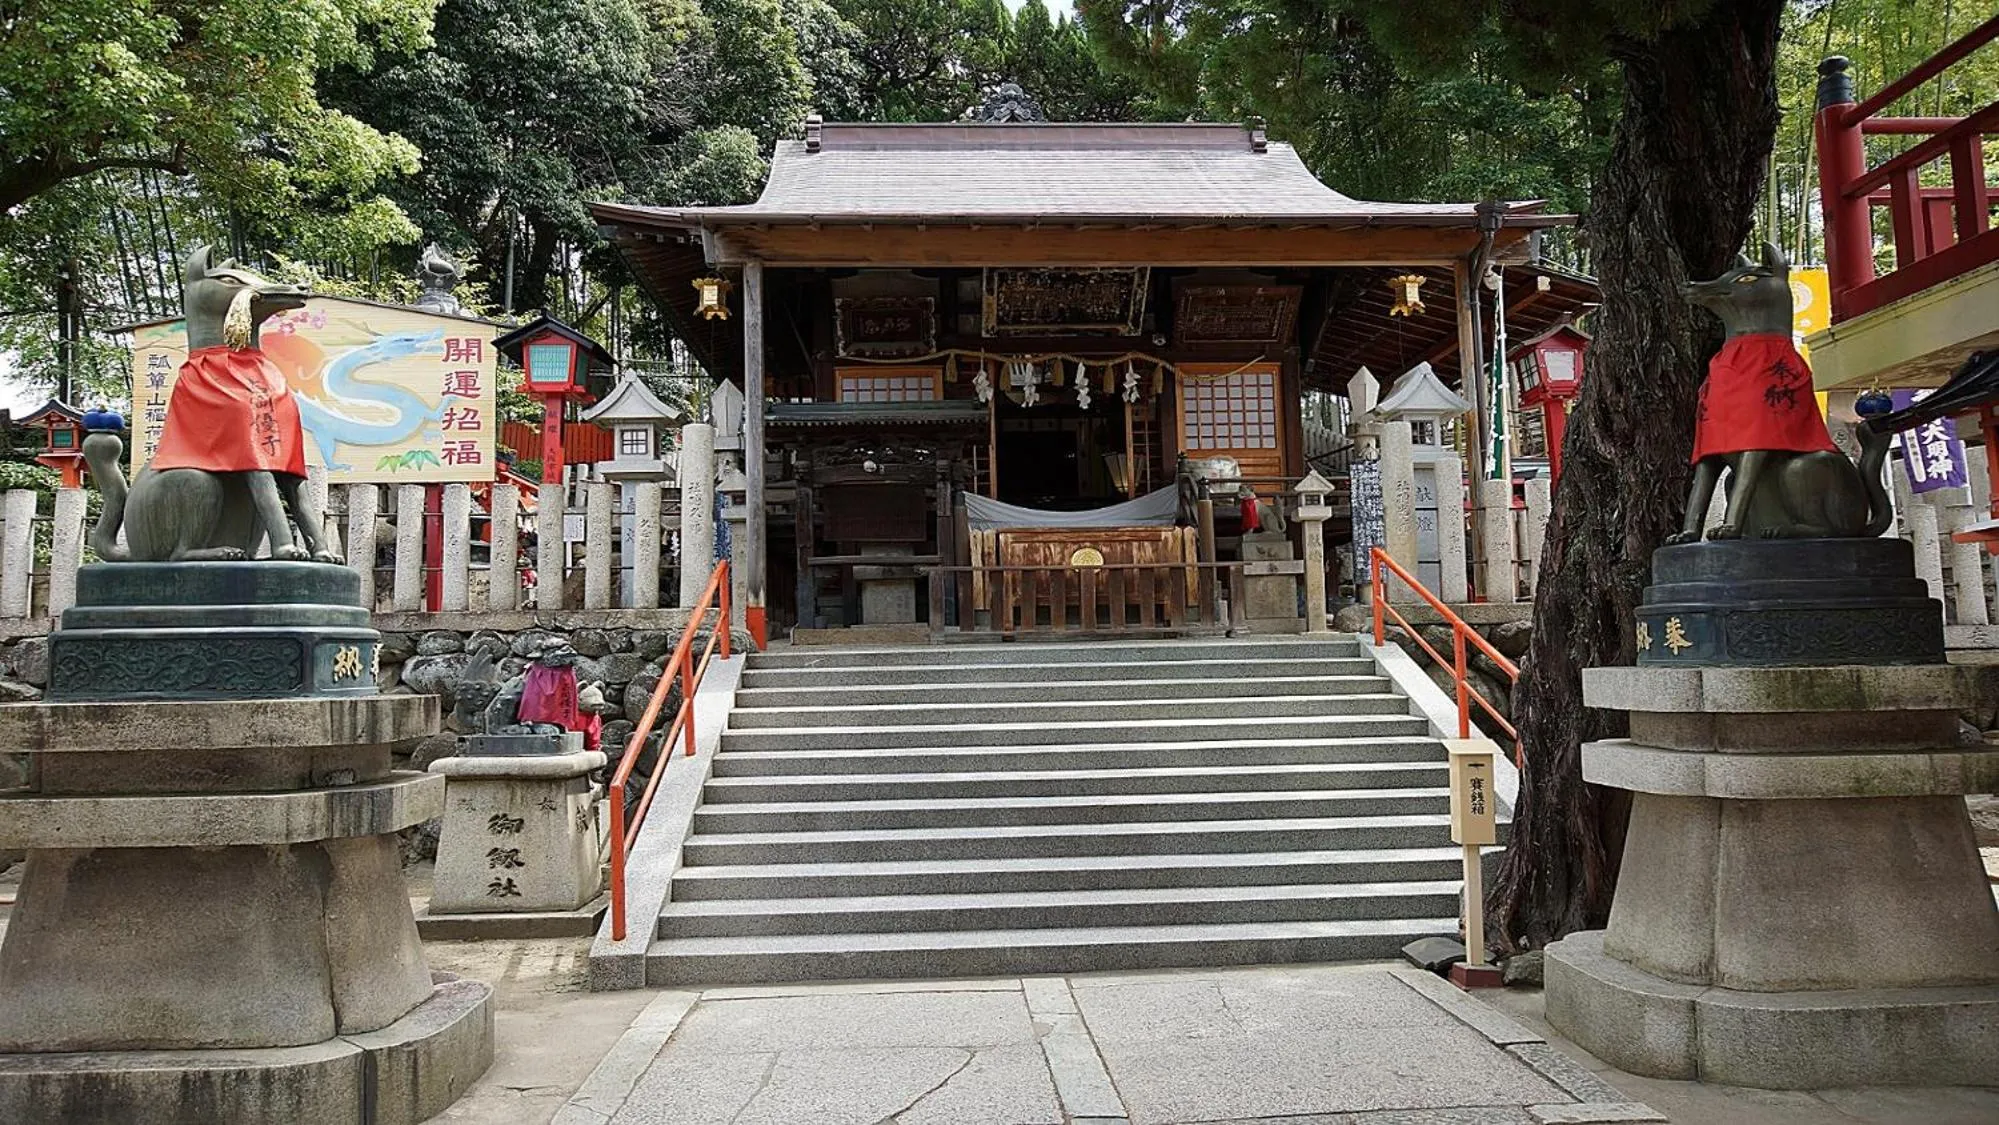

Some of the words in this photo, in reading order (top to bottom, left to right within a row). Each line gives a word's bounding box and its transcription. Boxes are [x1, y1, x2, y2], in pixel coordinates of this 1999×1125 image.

[441, 337, 483, 466] 開運招福
[1920, 417, 1955, 481] 大明神
